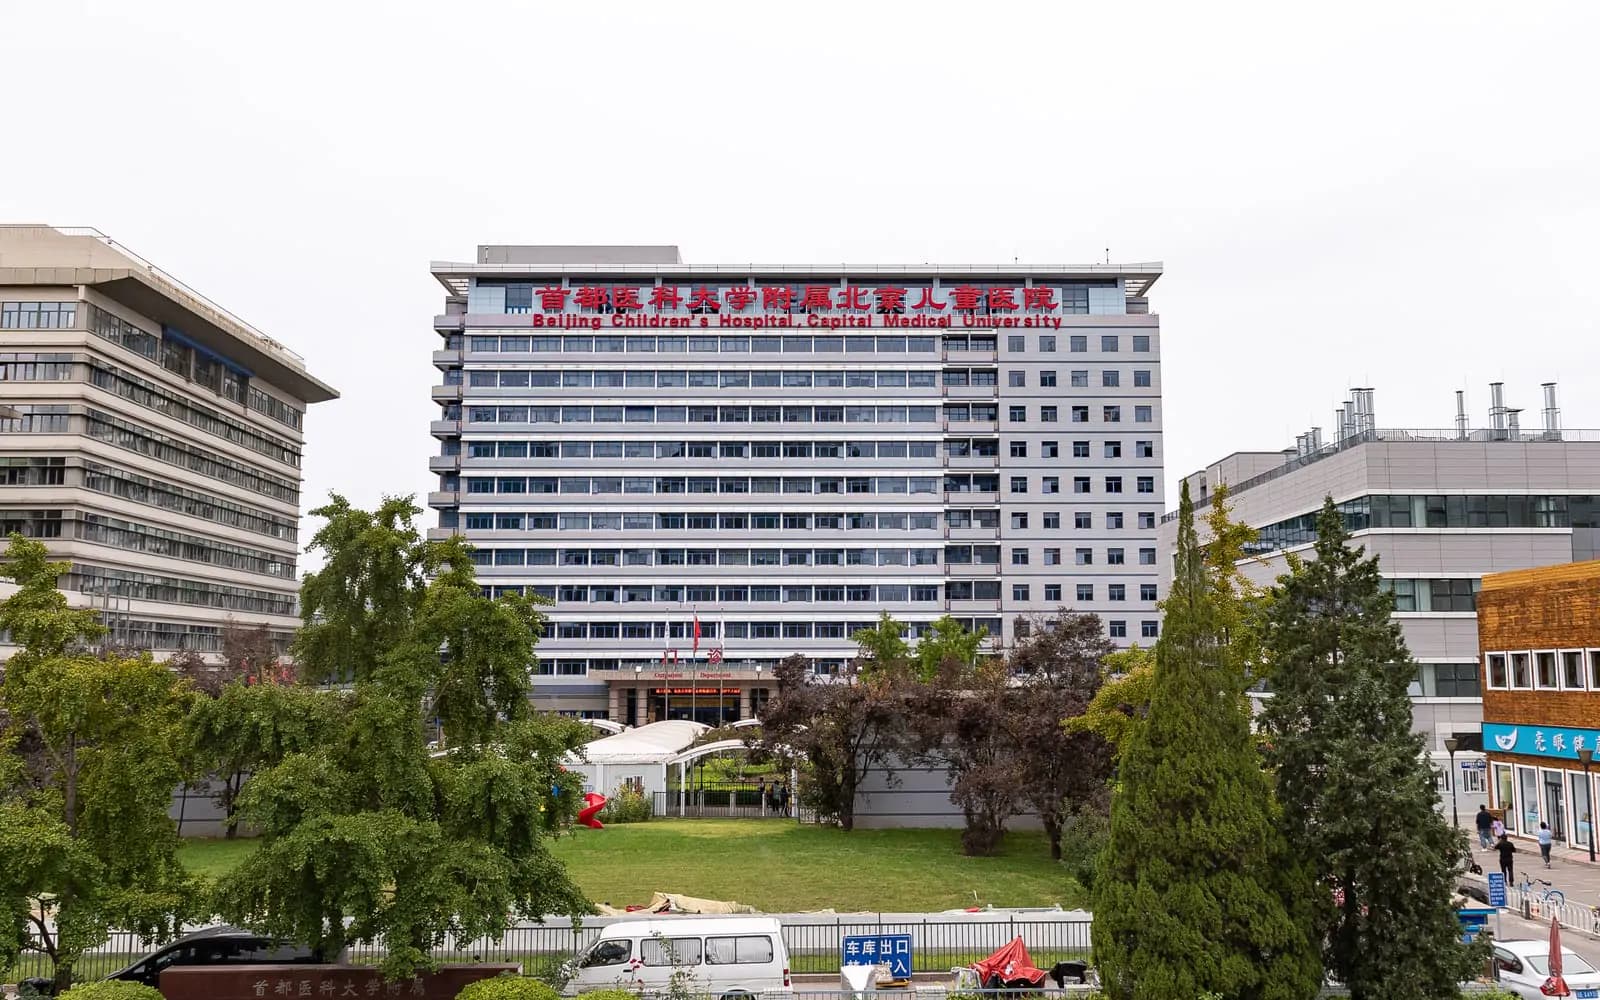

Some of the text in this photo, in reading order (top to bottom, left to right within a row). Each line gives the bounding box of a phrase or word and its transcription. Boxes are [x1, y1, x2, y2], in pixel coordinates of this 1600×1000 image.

[535, 285, 1058, 310] 首都医科大学附属北京儿童医院
[533, 313, 601, 330] Beijing
[611, 313, 709, 328] Children's
[883, 313, 952, 328] Medical
[963, 313, 1062, 330] University
[846, 939, 908, 956] 车库出口
